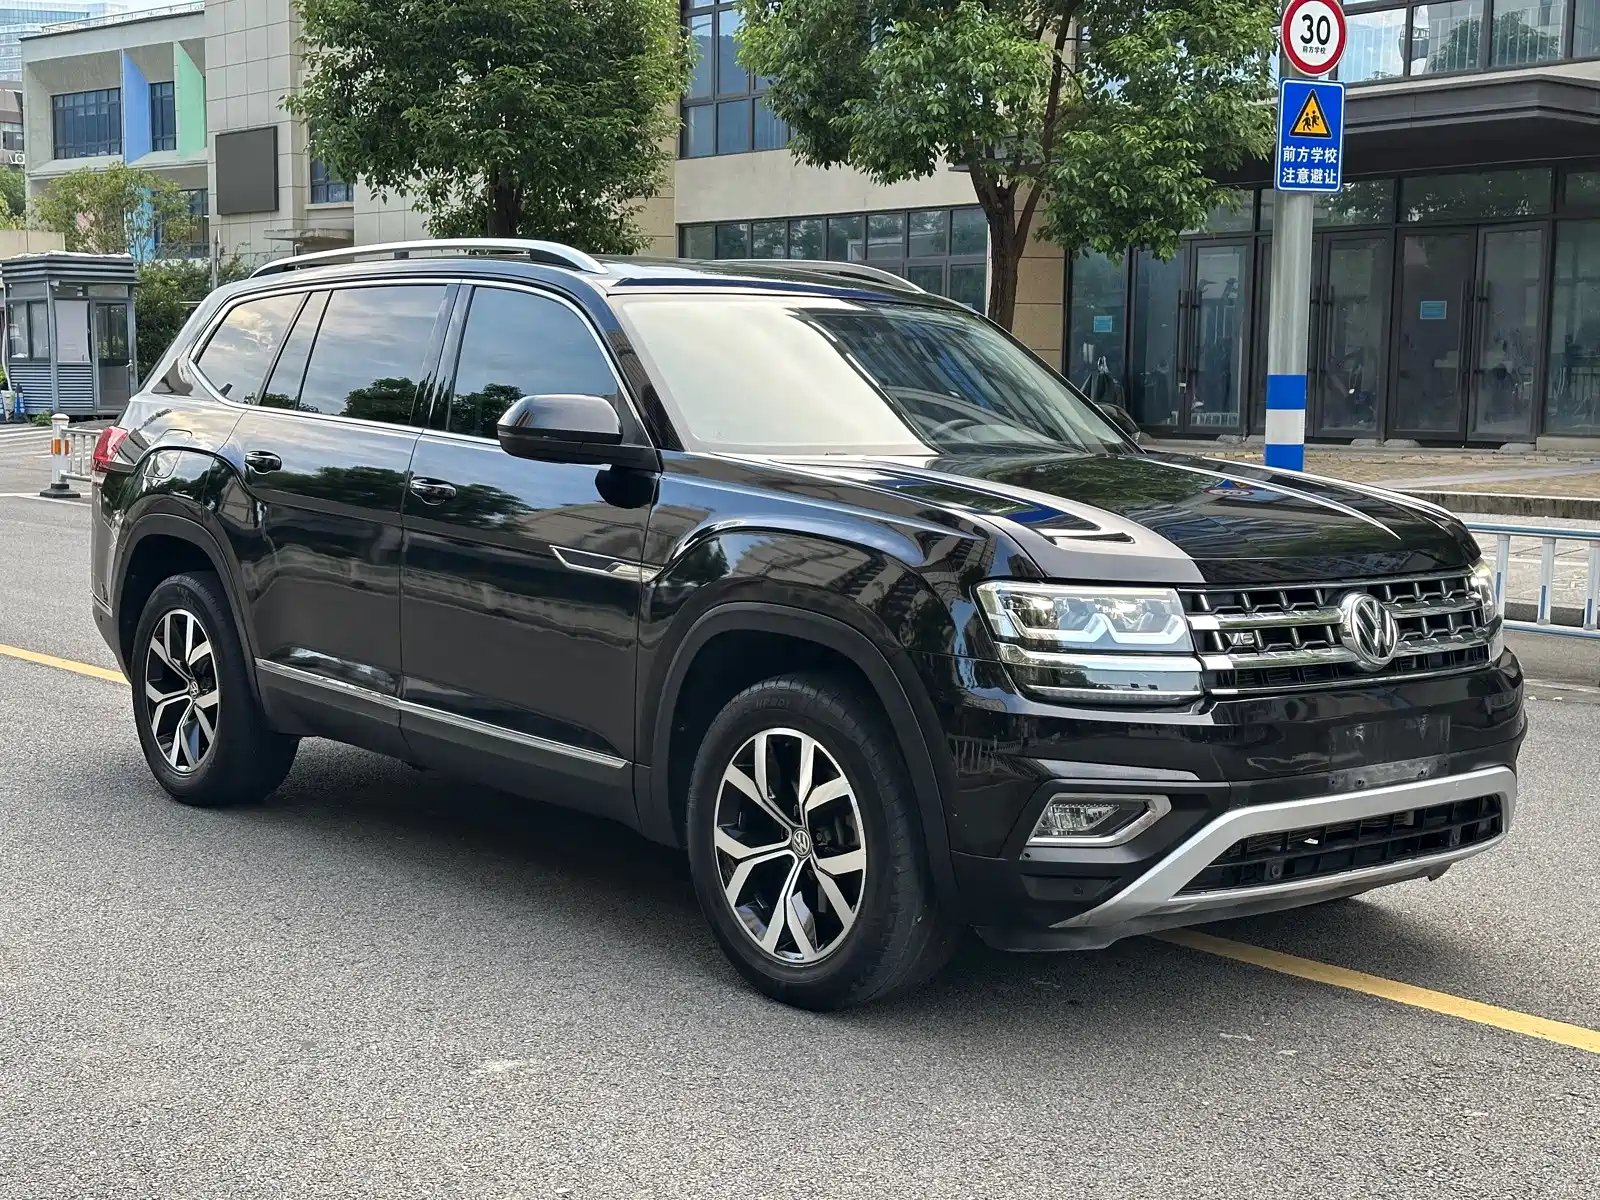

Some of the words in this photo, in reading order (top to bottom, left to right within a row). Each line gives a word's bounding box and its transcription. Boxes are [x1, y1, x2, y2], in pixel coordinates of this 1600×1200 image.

[1300, 13, 1331, 46] 30
[1302, 45, 1326, 54] 前方学校
[1283, 145, 1337, 164] 前方学校
[1282, 167, 1337, 184] 注意避让
[1225, 632, 1254, 646] V6
